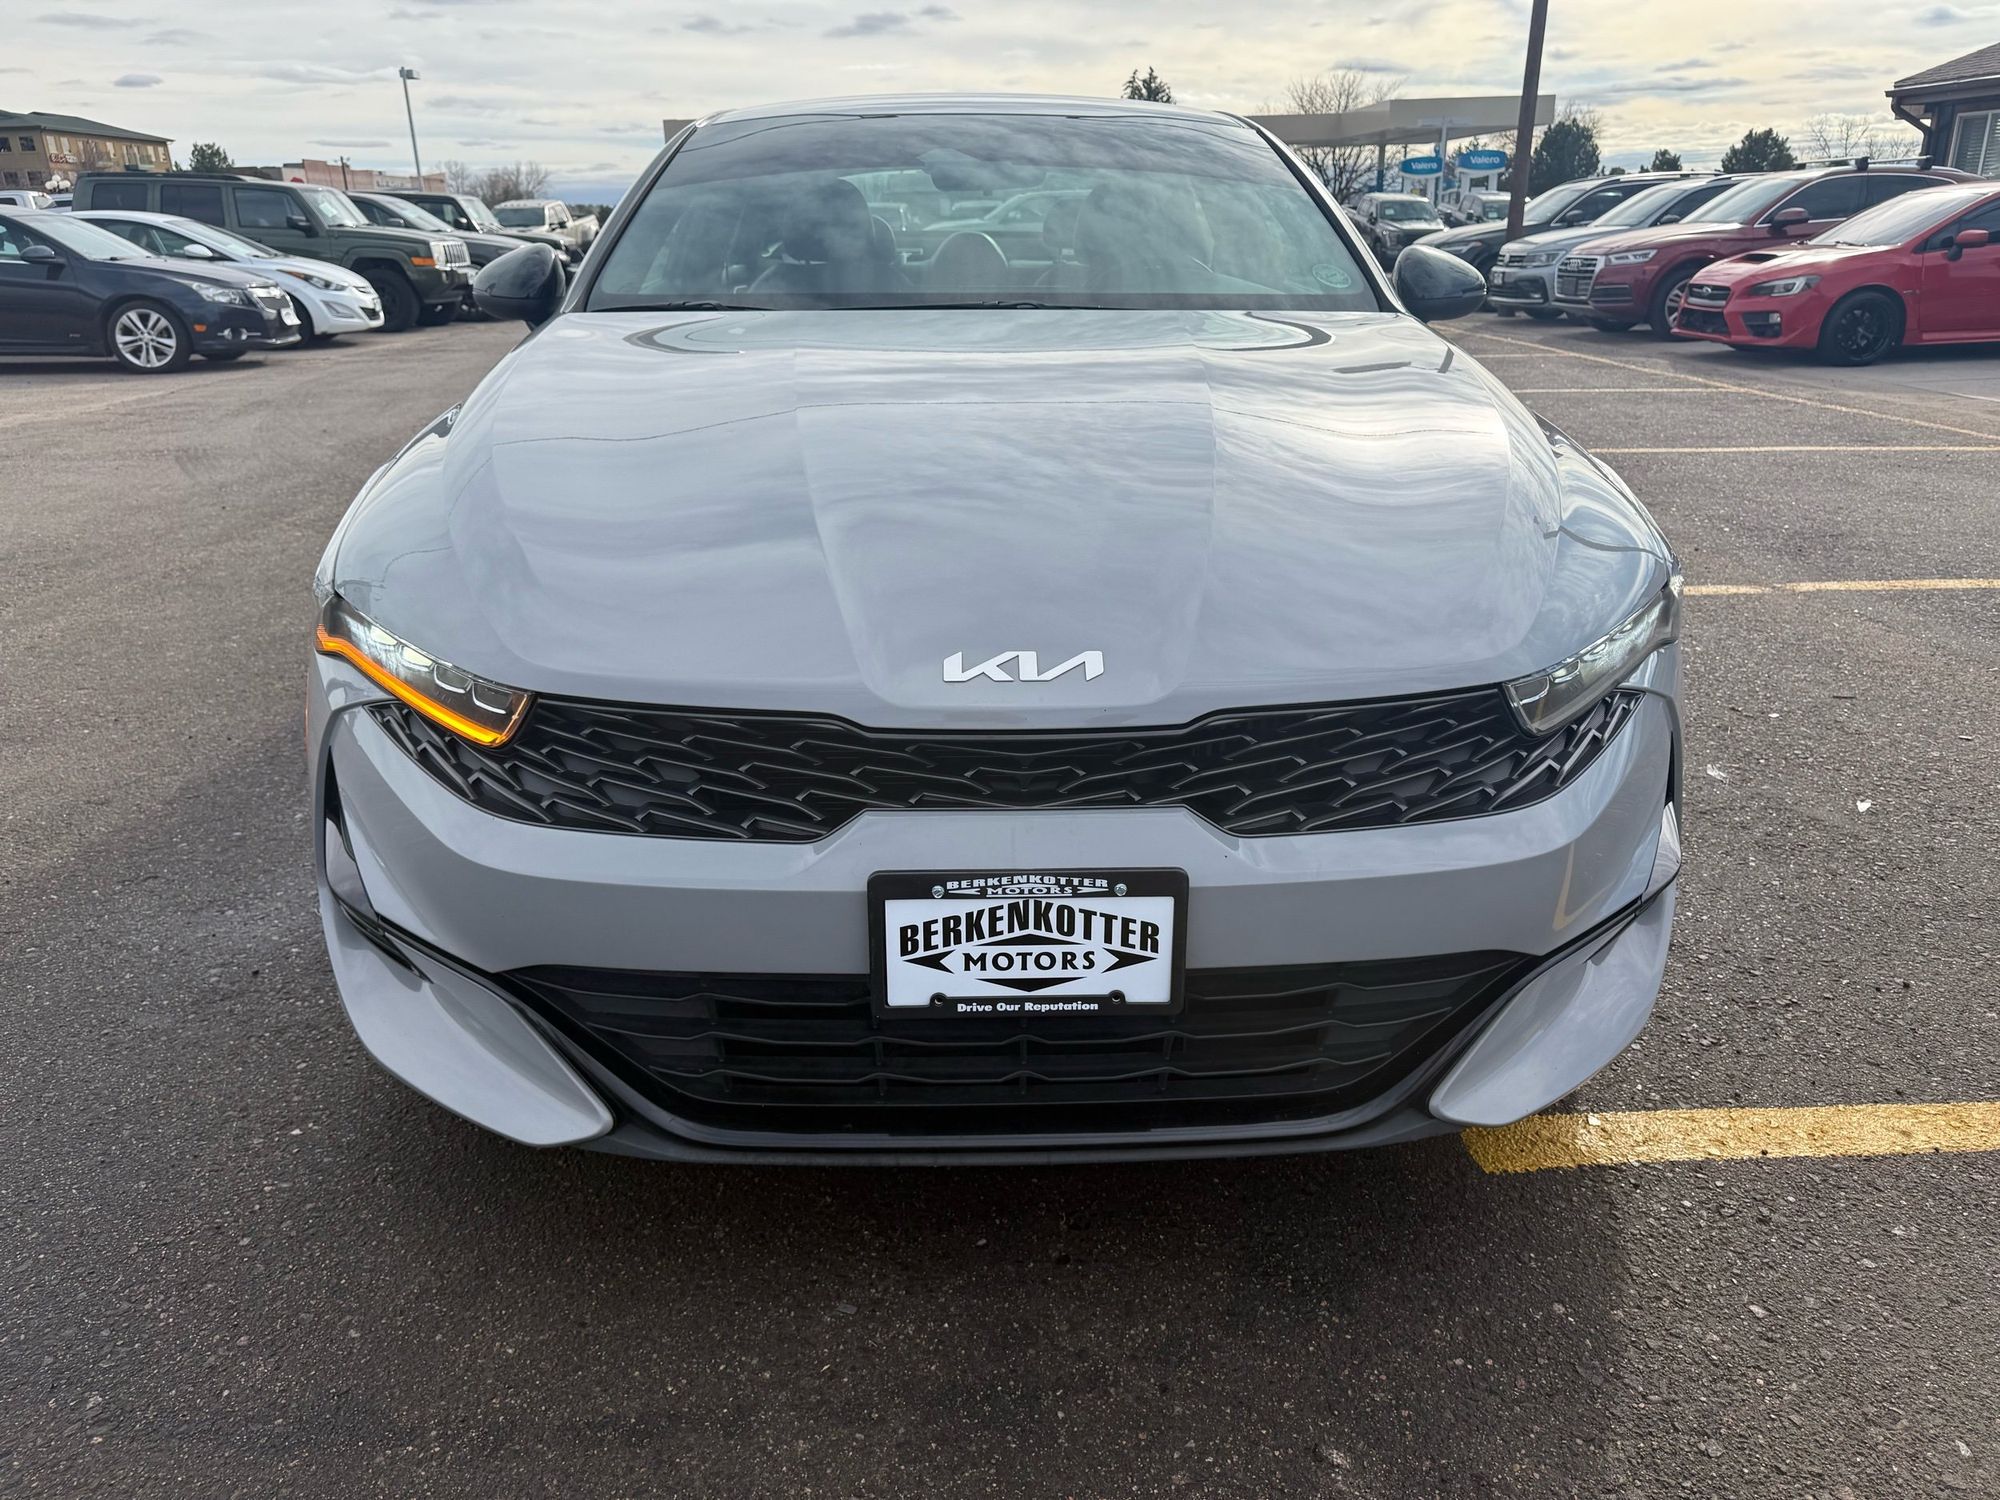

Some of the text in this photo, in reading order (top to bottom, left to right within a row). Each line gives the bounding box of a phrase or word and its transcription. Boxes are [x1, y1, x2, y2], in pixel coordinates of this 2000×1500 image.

[1411, 161, 1438, 170] Valero
[1470, 156, 1500, 164] Valero
[946, 874, 1109, 889] BERKENKOTTER
[986, 886, 1073, 896] MOTORS
[899, 898, 1160, 957] BERKENKOTTER
[962, 950, 1096, 971] MOTORS
[957, 1002, 1099, 1013] Drive Our Reputation
